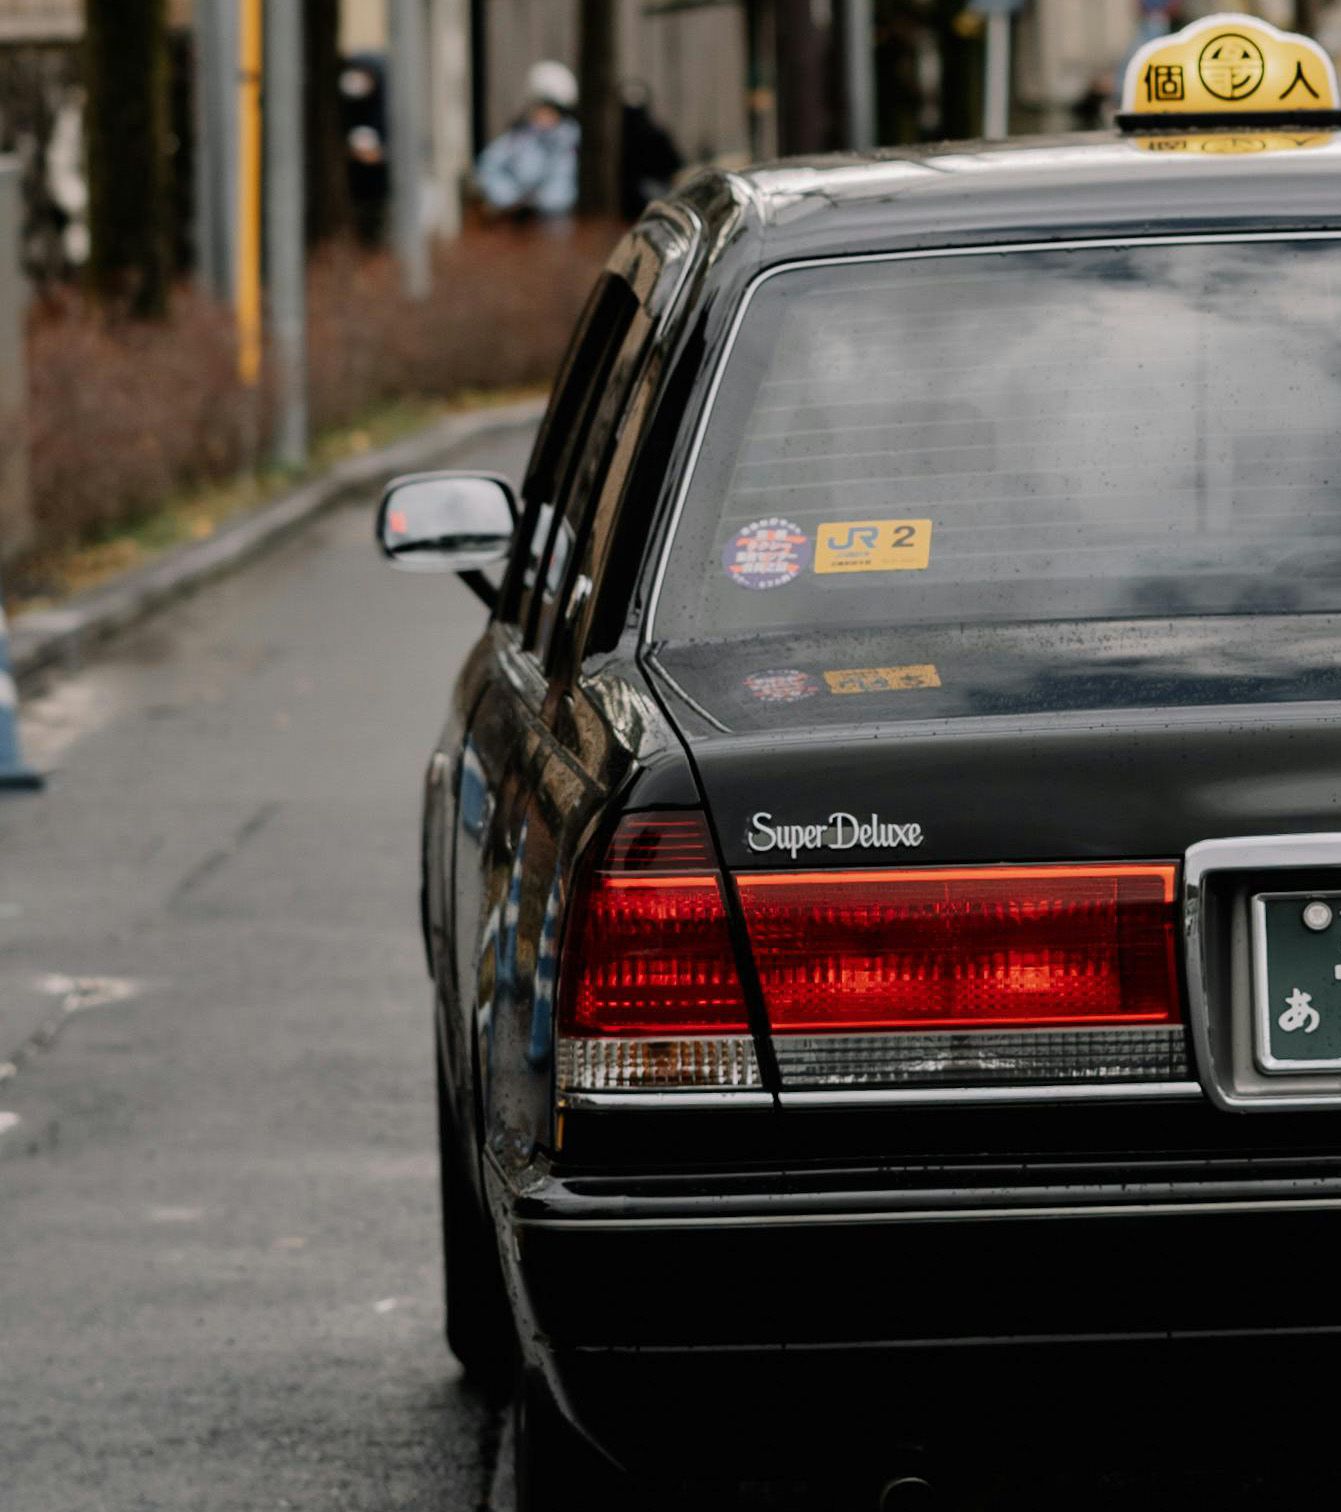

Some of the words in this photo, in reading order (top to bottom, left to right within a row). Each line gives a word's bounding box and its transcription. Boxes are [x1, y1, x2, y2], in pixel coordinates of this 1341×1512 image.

[827, 526, 880, 550] JR
[891, 525, 916, 548] 2
[748, 812, 827, 859] Super
[828, 812, 924, 849] Deluxe
